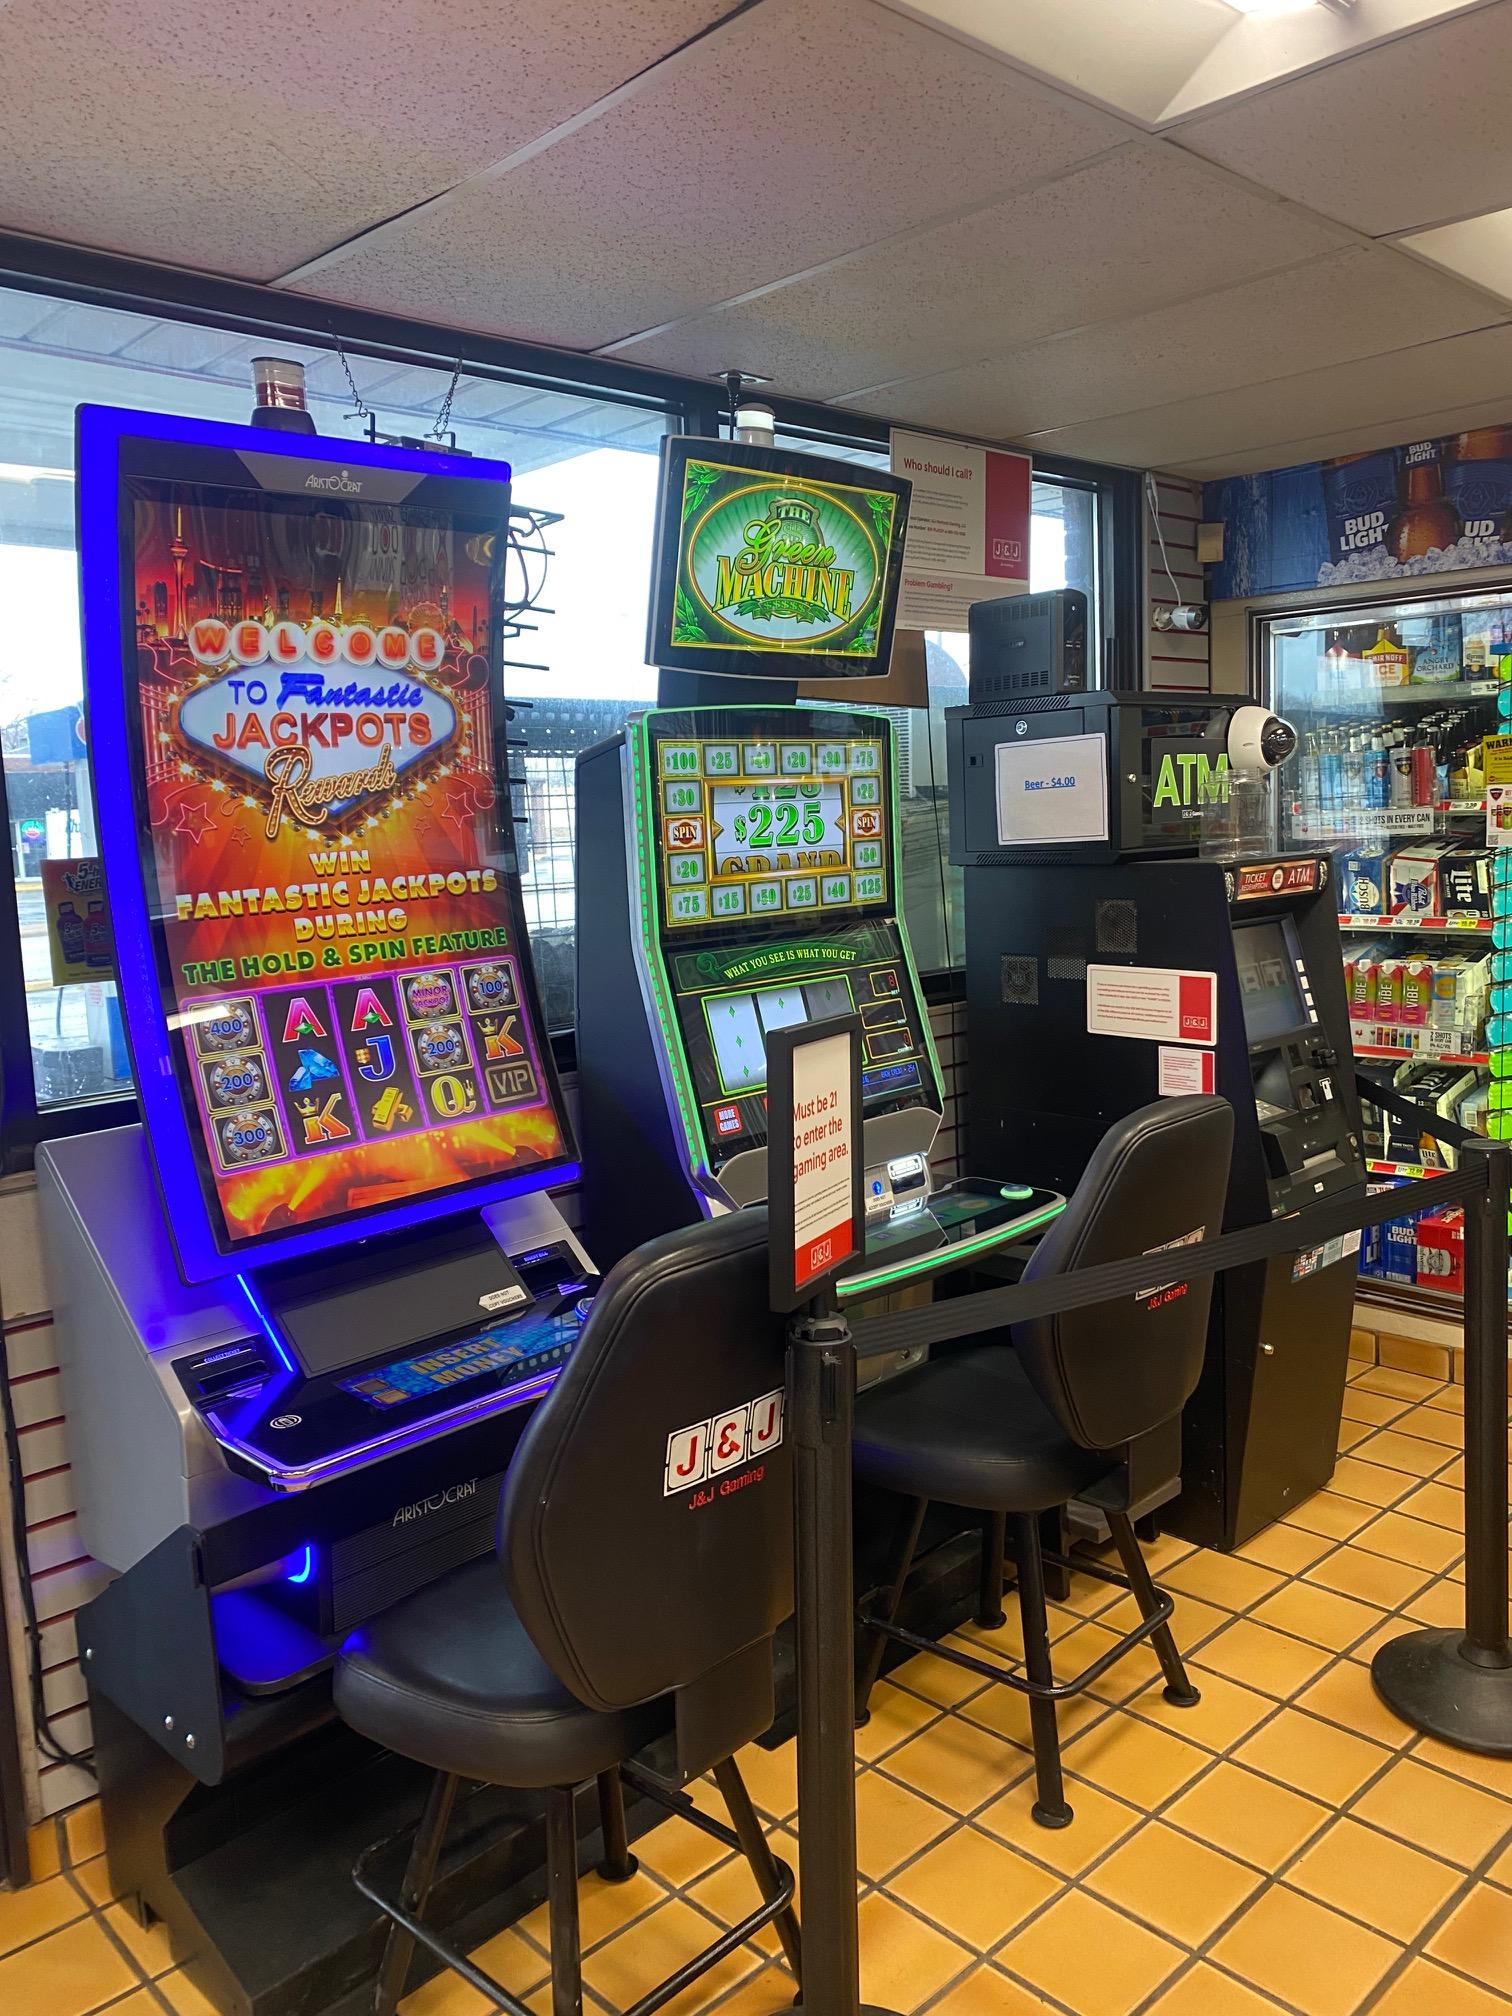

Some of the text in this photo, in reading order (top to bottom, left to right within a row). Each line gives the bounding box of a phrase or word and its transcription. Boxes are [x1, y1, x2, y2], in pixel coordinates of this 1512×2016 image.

[1405, 449, 1436, 465] LIGHT
[1408, 441, 1432, 455] BUD
[904, 457, 973, 480] Who should I call?
[305, 474, 362, 493] ARISTOCRAT
[778, 506, 812, 525] THE
[1345, 511, 1385, 535] BUD
[735, 519, 837, 576] Green
[712, 555, 855, 624] MACHINE
[904, 578, 926, 587] Problem
[194, 626, 437, 658] WELCOME
[1416, 663, 1454, 672] ORCHARD
[228, 672, 424, 710] TO Fantastic
[212, 711, 433, 749] JACKPOTS
[264, 743, 396, 838] Rewards
[1025, 779, 1043, 790] Beer
[1051, 776, 1076, 788] $4.00
[1153, 753, 1230, 808] ATM
[733, 801, 825, 848] $225
[857, 815, 876, 830] SPIN
[1386, 814, 1394, 824] IN
[1395, 813, 1416, 824] EVERY
[1416, 812, 1431, 823] CAN
[673, 825, 697, 842] SPIN
[309, 850, 371, 876] WIN
[1245, 868, 1310, 885] TICKET ATM
[176, 868, 498, 921] FANTASTIC JACKPOTS
[1359, 876, 1370, 911] BUSCH
[1450, 869, 1473, 903] Lite
[294, 907, 409, 943] DURING
[182, 927, 507, 985] THE HOLD & SPIN FEATURE
[723, 948, 857, 980] WHAT YOU SEE IS WHAT YOU GET
[412, 984, 449, 998] MINOR
[478, 979, 503, 995] 100
[282, 997, 327, 1043] A
[350, 987, 393, 1031] A
[210, 1018, 243, 1035] 400
[485, 1015, 523, 1060] K
[1435, 1031, 1452, 1039] SHOTS
[358, 1034, 396, 1082] J
[427, 1039, 455, 1056] 200
[220, 1073, 253, 1092] 200
[430, 1075, 477, 1117] Q
[492, 1069, 529, 1095] VIP
[302, 1092, 350, 1144] K
[718, 1108, 736, 1120] MORE
[794, 1091, 838, 1121] Must be 21
[233, 1127, 266, 1146] 300
[719, 1118, 740, 1132] GAMES
[803, 1122, 828, 1146] enter
[828, 1115, 843, 1136] the
[793, 1142, 849, 1185] gaming area.
[1387, 1232, 1418, 1245] LIGHT
[1391, 1226, 1415, 1236] BUD
[409, 1336, 504, 1376] INSERT
[430, 1345, 524, 1386] MONEY
[688, 1465, 765, 1510] J&J Gaming
